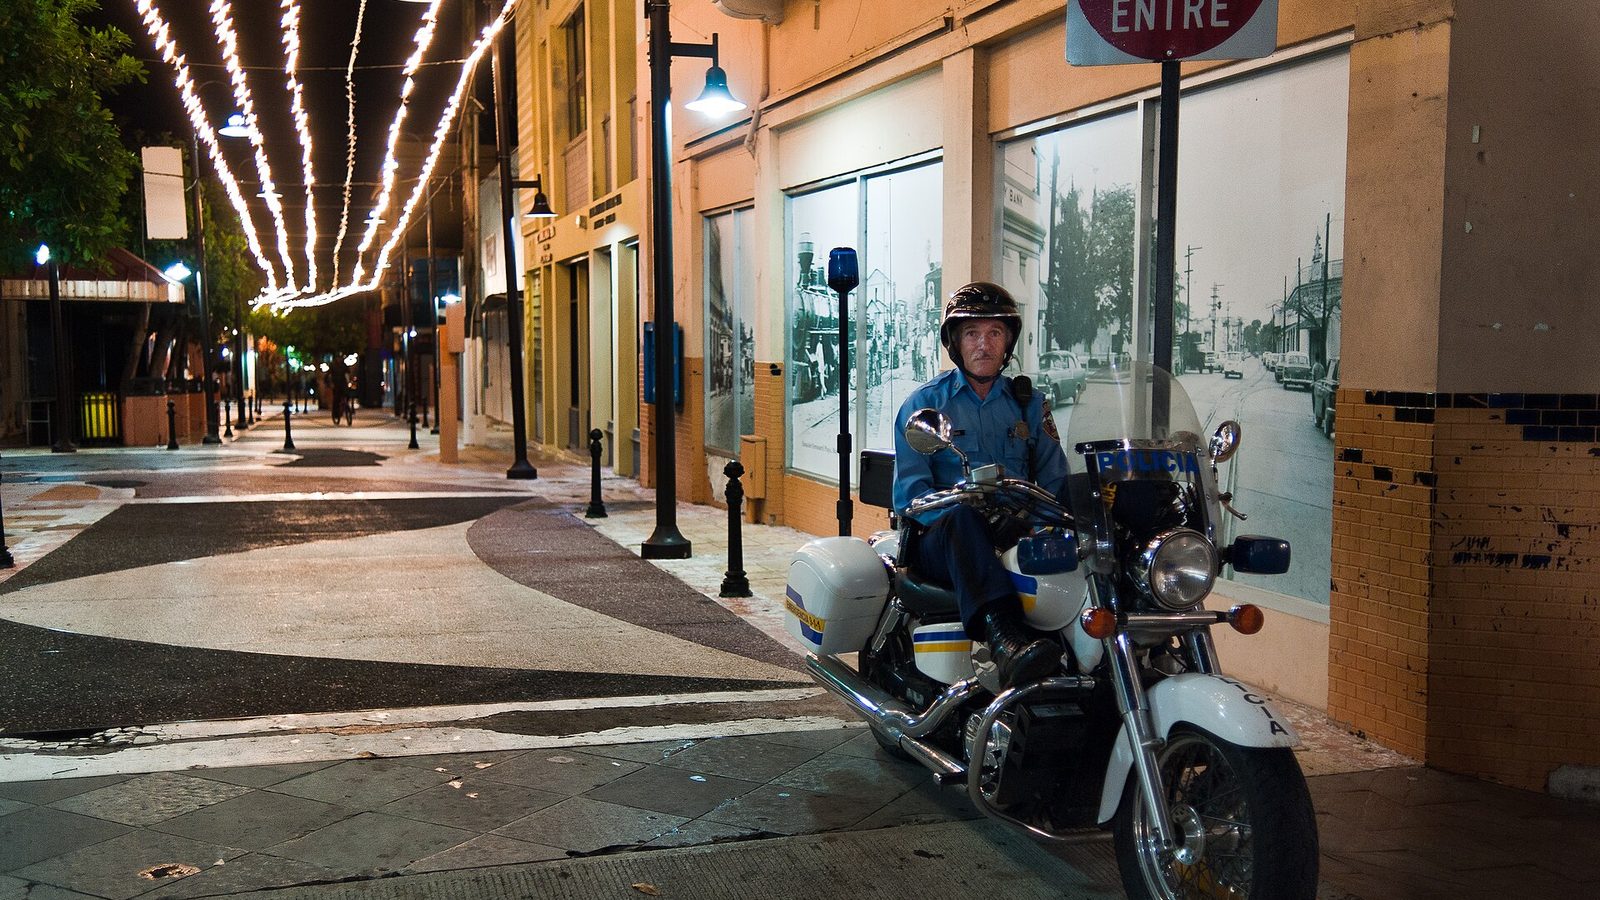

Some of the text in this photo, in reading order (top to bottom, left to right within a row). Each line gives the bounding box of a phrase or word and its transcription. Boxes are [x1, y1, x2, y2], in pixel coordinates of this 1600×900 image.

[1112, 0, 1230, 33] ENTRE
[1009, 189, 1023, 205] BANK
[1098, 450, 1200, 474] POLICIA
